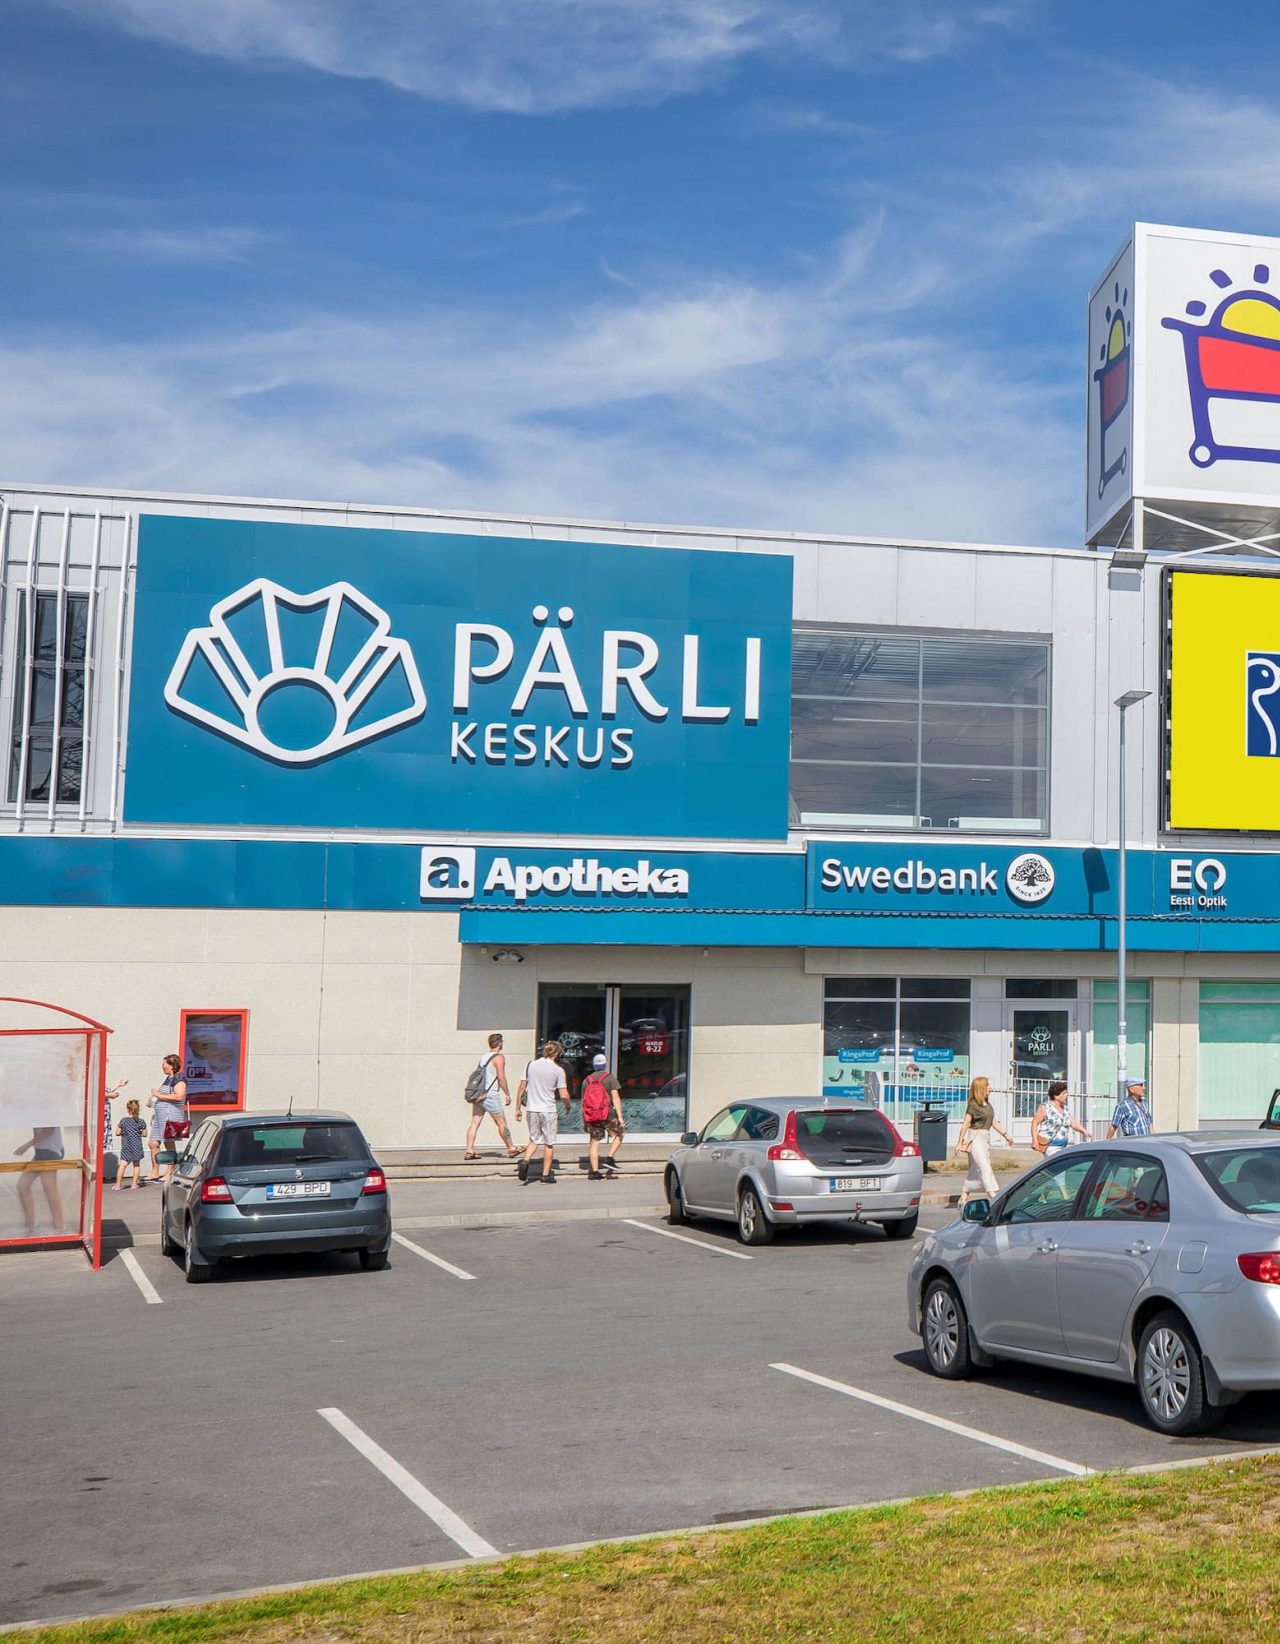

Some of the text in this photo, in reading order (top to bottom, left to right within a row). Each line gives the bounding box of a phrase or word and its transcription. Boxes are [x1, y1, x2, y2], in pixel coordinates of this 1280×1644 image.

[453, 605, 761, 720] PÄRLI
[451, 721, 634, 764] KESKUS
[483, 857, 689, 899] Apotheka
[820, 858, 998, 890] Swedbank
[1170, 858, 1226, 890] EO
[1170, 895, 1227, 908] Eesti Optik
[1028, 1041, 1054, 1051] PÄRLI
[843, 1049, 876, 1059] KingaProf
[918, 1048, 950, 1058] KingaProf
[277, 1184, 297, 1195] 429
[837, 1179, 853, 1189] 819
